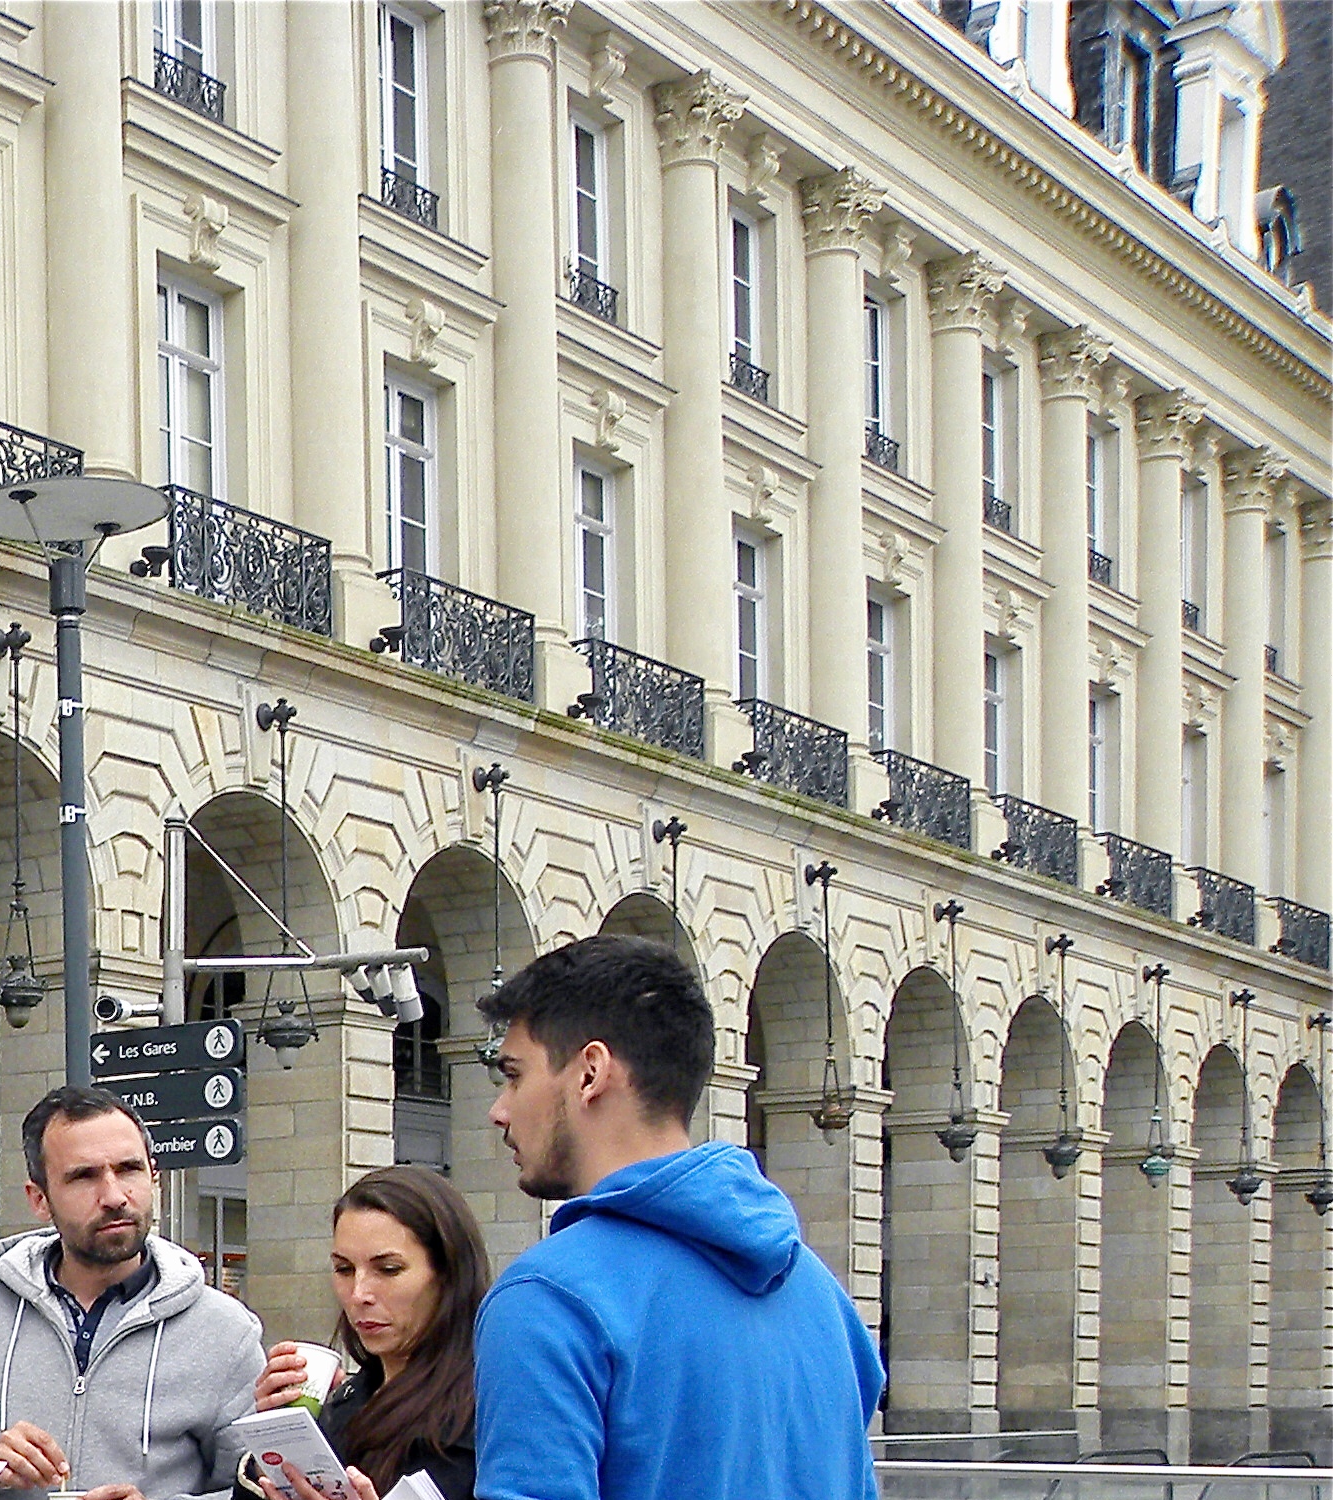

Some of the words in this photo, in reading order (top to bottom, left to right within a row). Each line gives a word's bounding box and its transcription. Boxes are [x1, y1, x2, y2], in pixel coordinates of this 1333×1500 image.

[118, 1045, 139, 1059] Les
[142, 1041, 177, 1057] Gares
[151, 1137, 196, 1154] lombier
